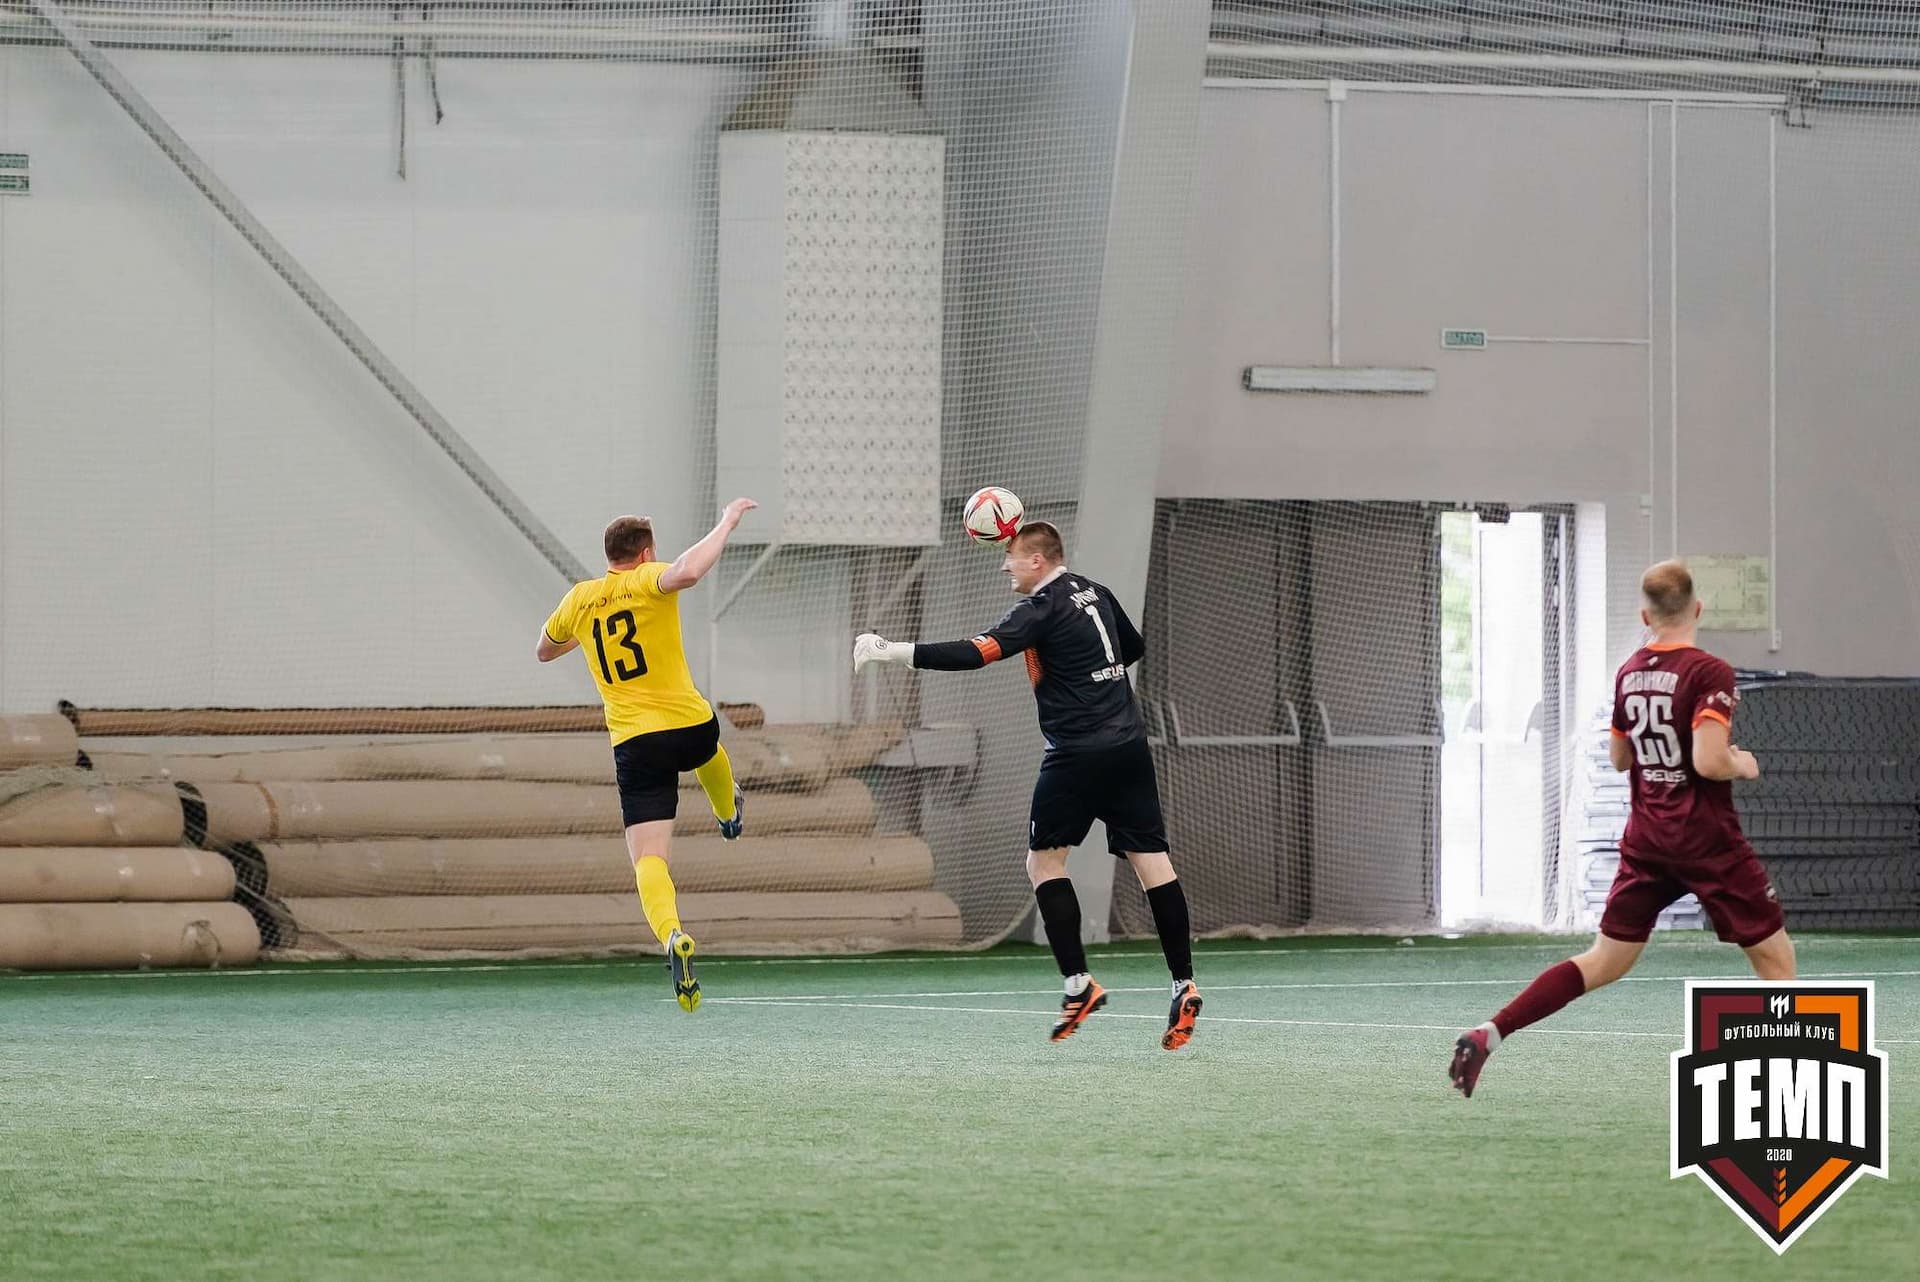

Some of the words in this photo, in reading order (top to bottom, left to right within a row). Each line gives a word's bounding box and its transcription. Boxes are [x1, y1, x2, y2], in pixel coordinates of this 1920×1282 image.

[593, 610, 648, 684] 13
[1084, 605, 1115, 663] 1
[1625, 694, 1682, 768] 25
[1642, 768, 1686, 783] SEUS
